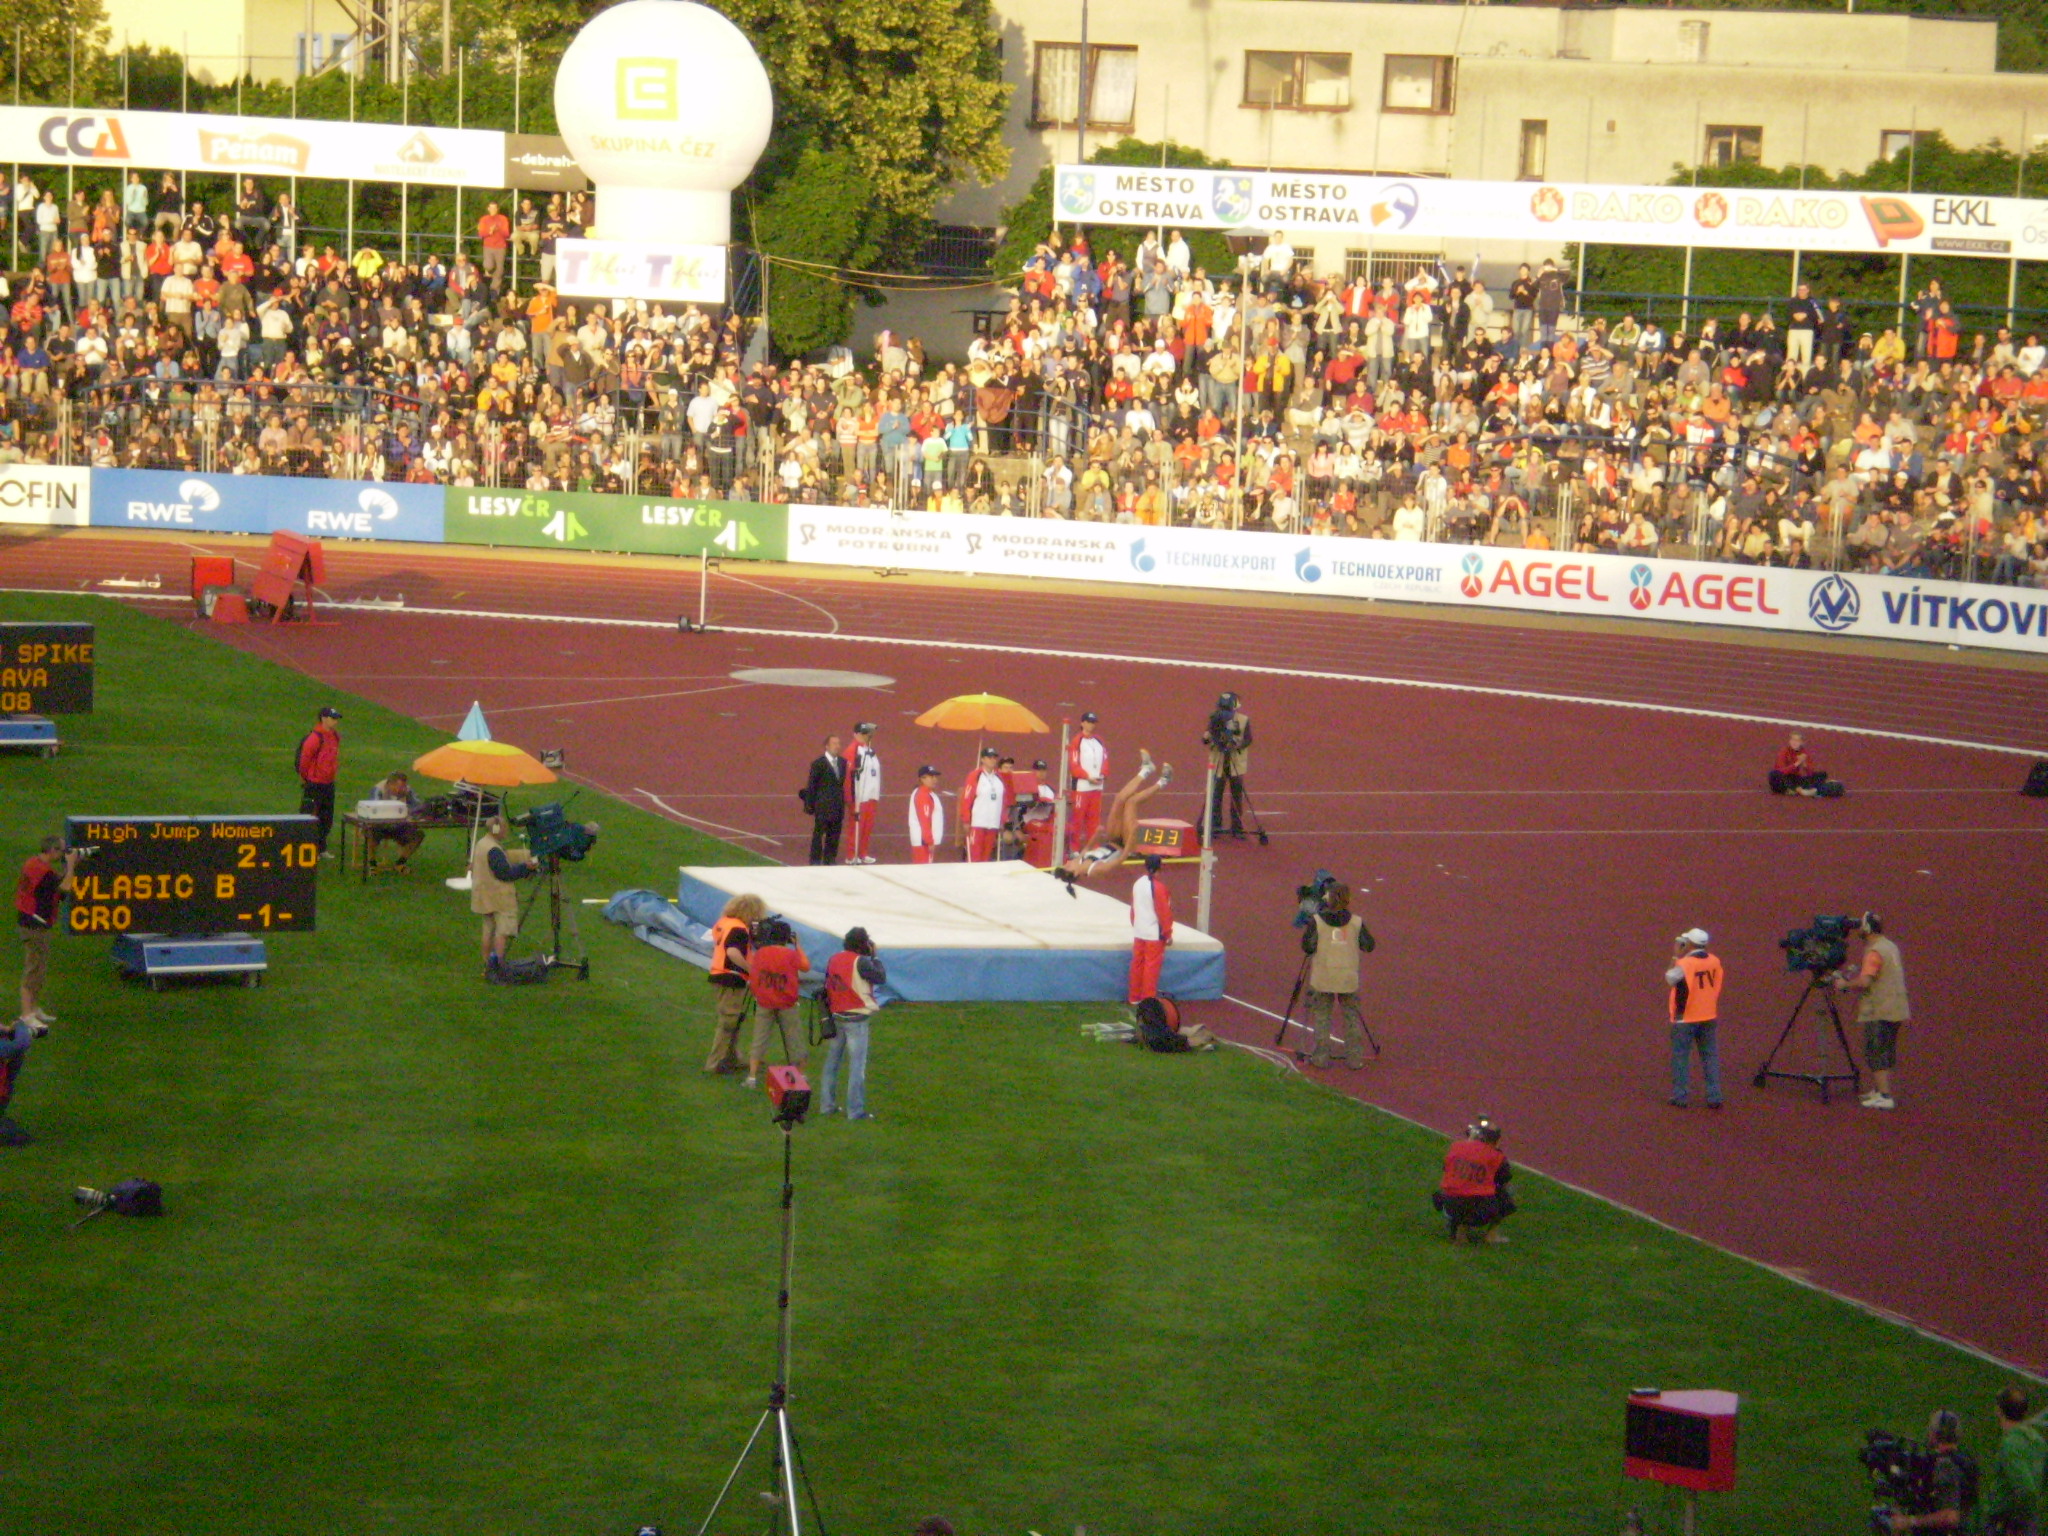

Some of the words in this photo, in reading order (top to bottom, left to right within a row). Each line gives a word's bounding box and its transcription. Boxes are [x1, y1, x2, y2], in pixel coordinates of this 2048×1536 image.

[38, 115, 131, 159] CCA
[1099, 200, 1204, 221] OSTRAVA
[1258, 205, 1360, 224] OSTRAVA
[1572, 191, 1684, 224] RAKO
[1736, 196, 1848, 229] RAKO
[1932, 198, 1997, 227] EKKL
[1936, 238, 2005, 252] WWW.EKKL.CZ
[127, 501, 193, 523] RWE
[307, 510, 373, 532] RWE
[1166, 550, 1276, 571] TECHNOEXPORT
[1332, 560, 1442, 583] TECHNOEXPORT
[1488, 559, 1609, 602] AGEL
[1657, 571, 1779, 615] AGEL
[18, 644, 94, 664] SPIKE
[87, 823, 137, 843] High
[150, 823, 200, 841] Jump
[211, 822, 273, 838] Women
[1143, 828, 1178, 845] 1:33
[238, 843, 316, 868] 2.10
[72, 874, 194, 900] VLASIC
[216, 874, 235, 898] B
[70, 905, 131, 930] CRO
[1694, 969, 1716, 989] TV
